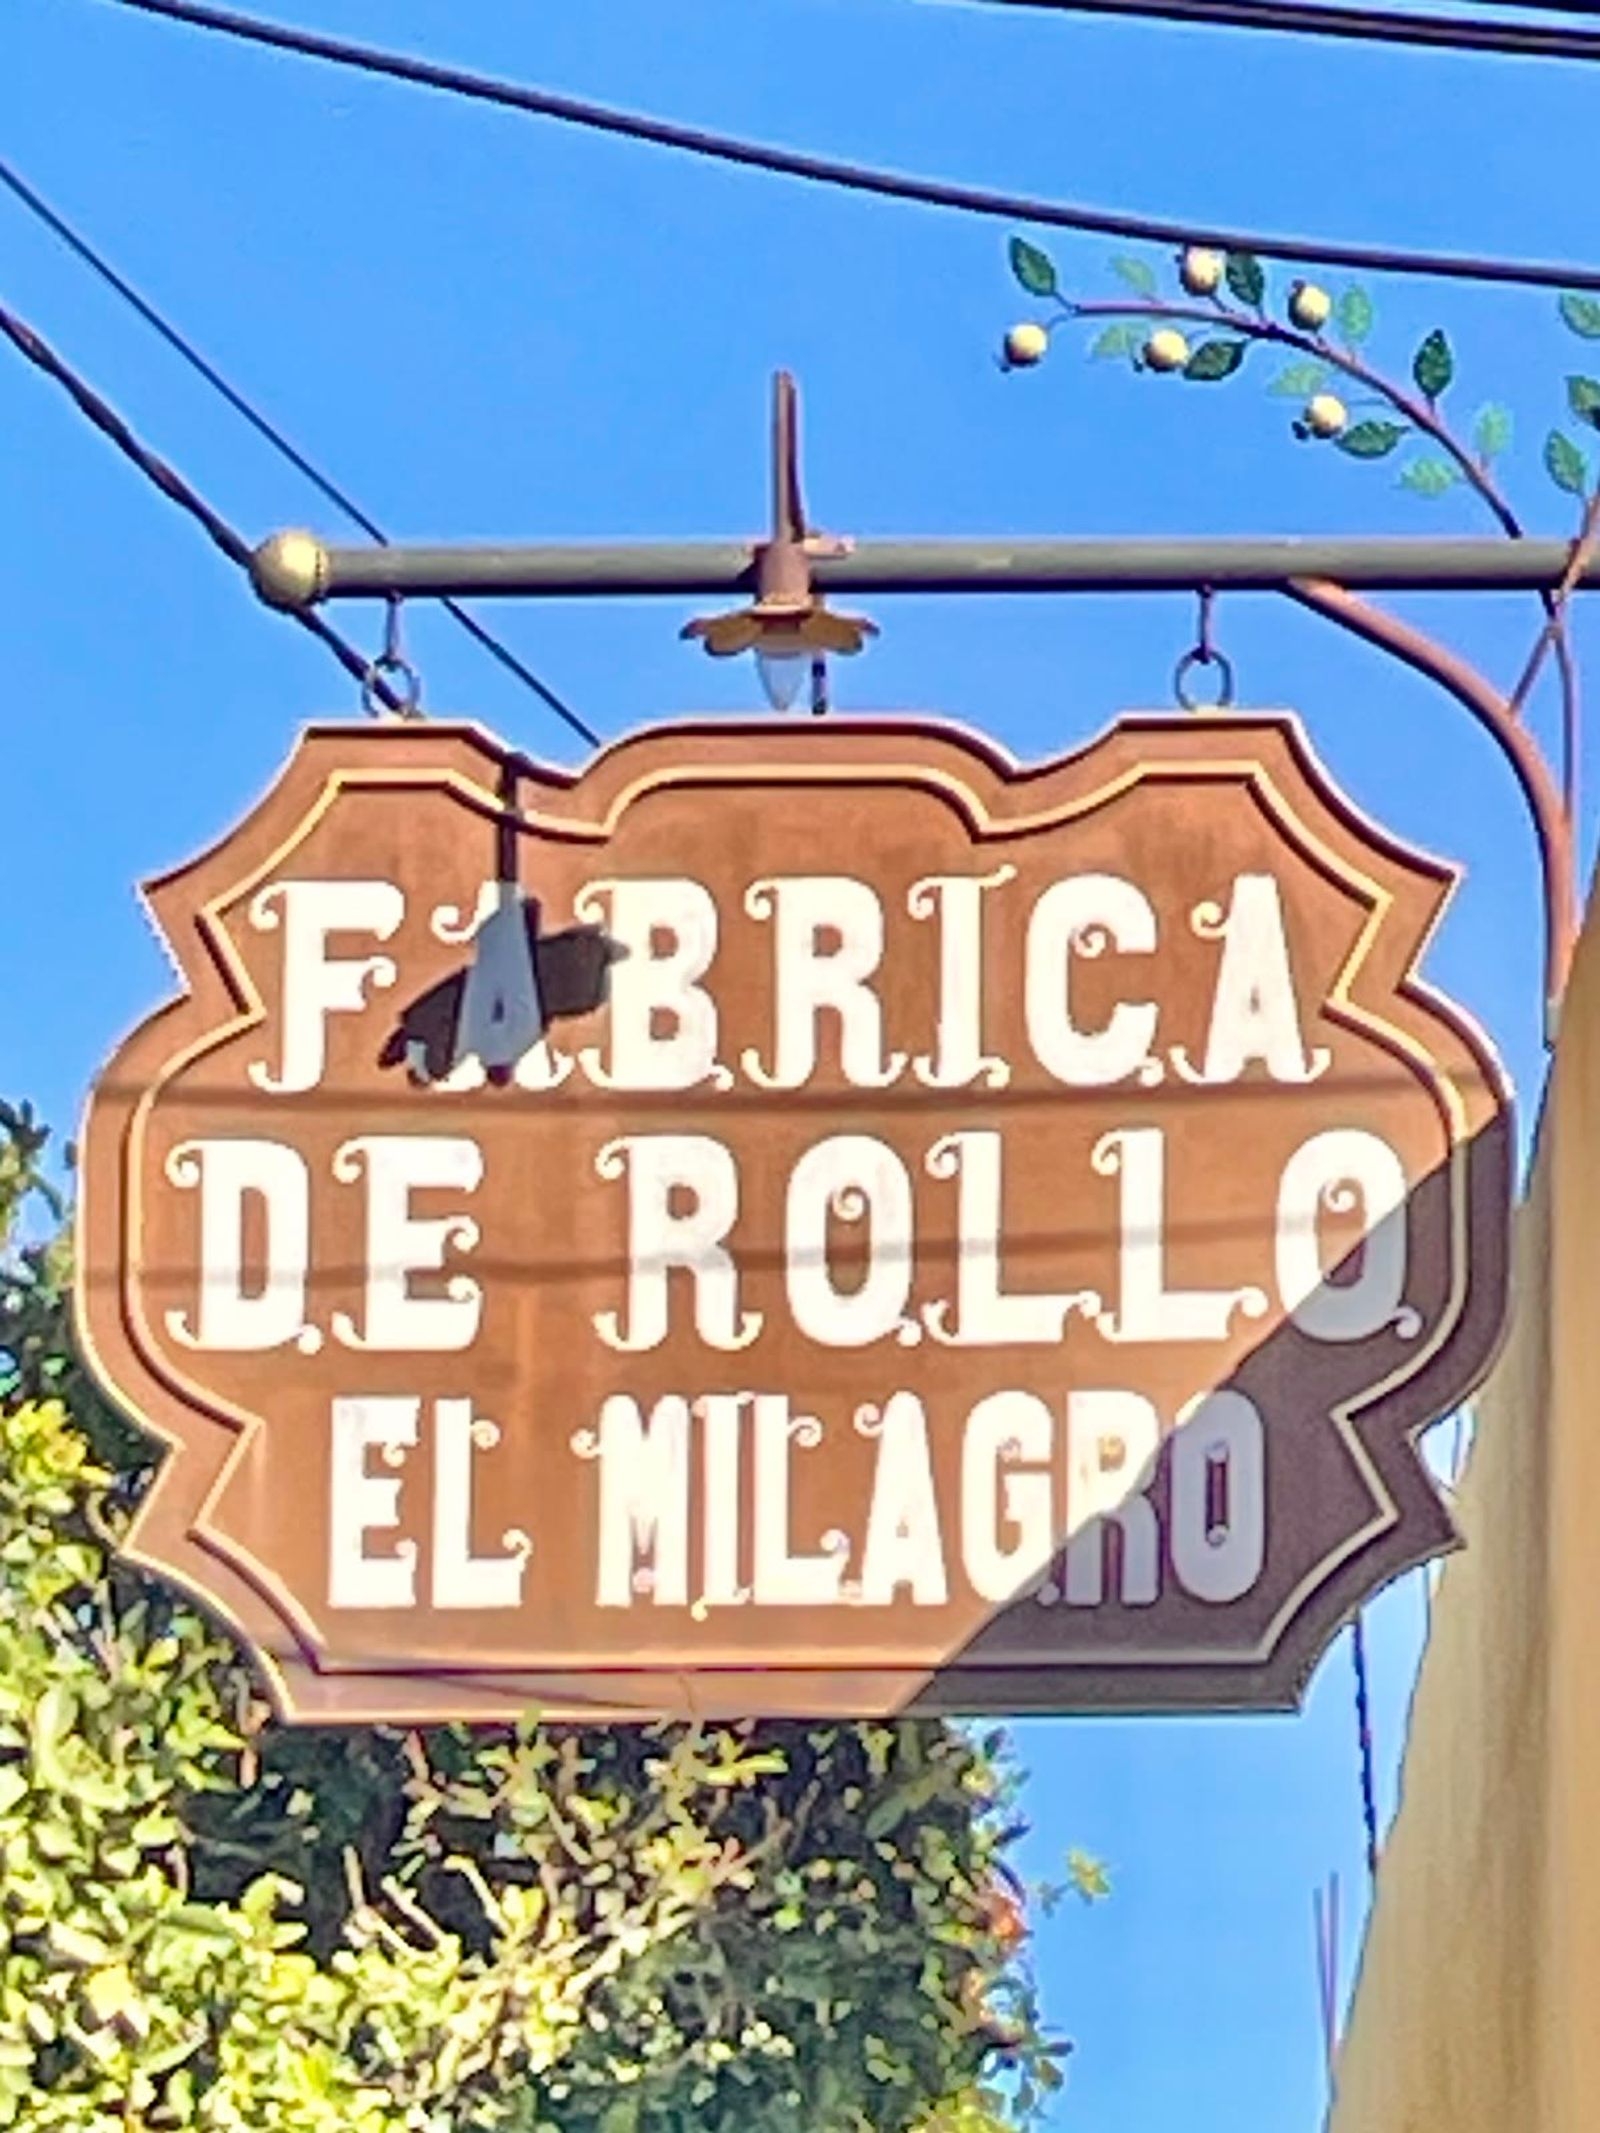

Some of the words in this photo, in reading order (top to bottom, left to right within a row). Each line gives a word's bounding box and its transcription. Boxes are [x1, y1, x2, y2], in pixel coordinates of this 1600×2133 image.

[247, 864, 1332, 1093] FABRICA
[164, 1135, 484, 1354] DE
[593, 1127, 1423, 1354] ROLLO
[328, 1395, 532, 1610] EL
[569, 1389, 1267, 1619] MILAGRO
